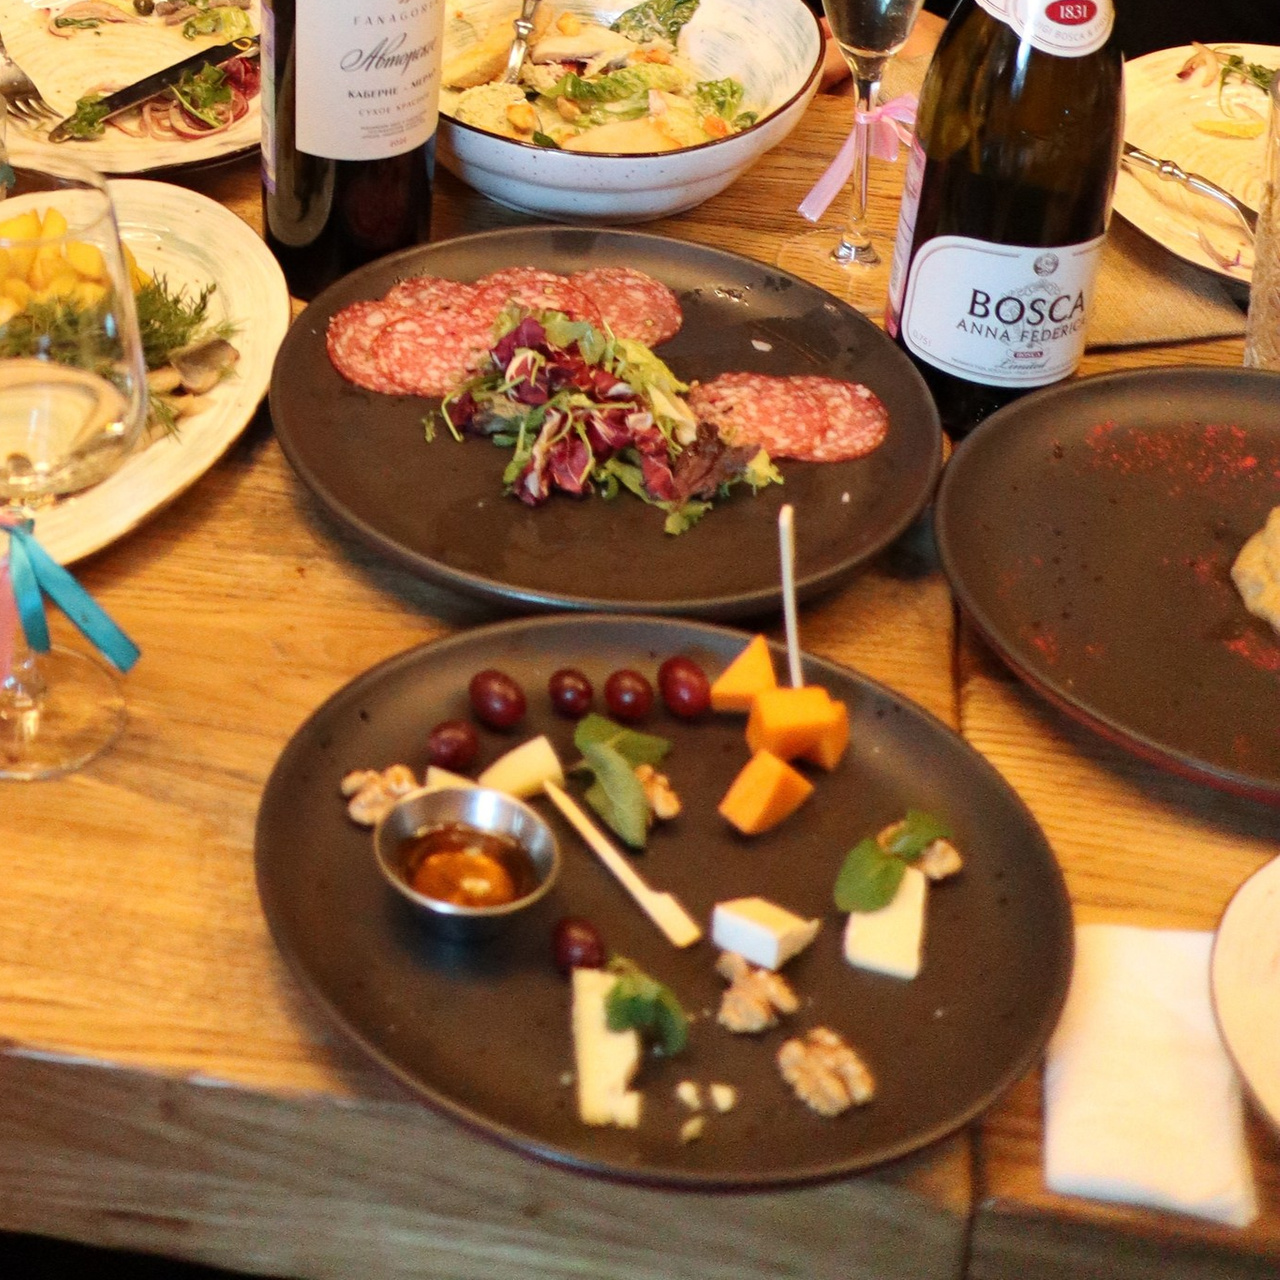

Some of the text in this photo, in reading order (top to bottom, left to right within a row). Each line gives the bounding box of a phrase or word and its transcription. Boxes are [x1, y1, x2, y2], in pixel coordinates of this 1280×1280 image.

[1059, 4, 1088, 20] 1831
[967, 288, 1084, 326] BOSCA
[956, 318, 1011, 342] ANNA
